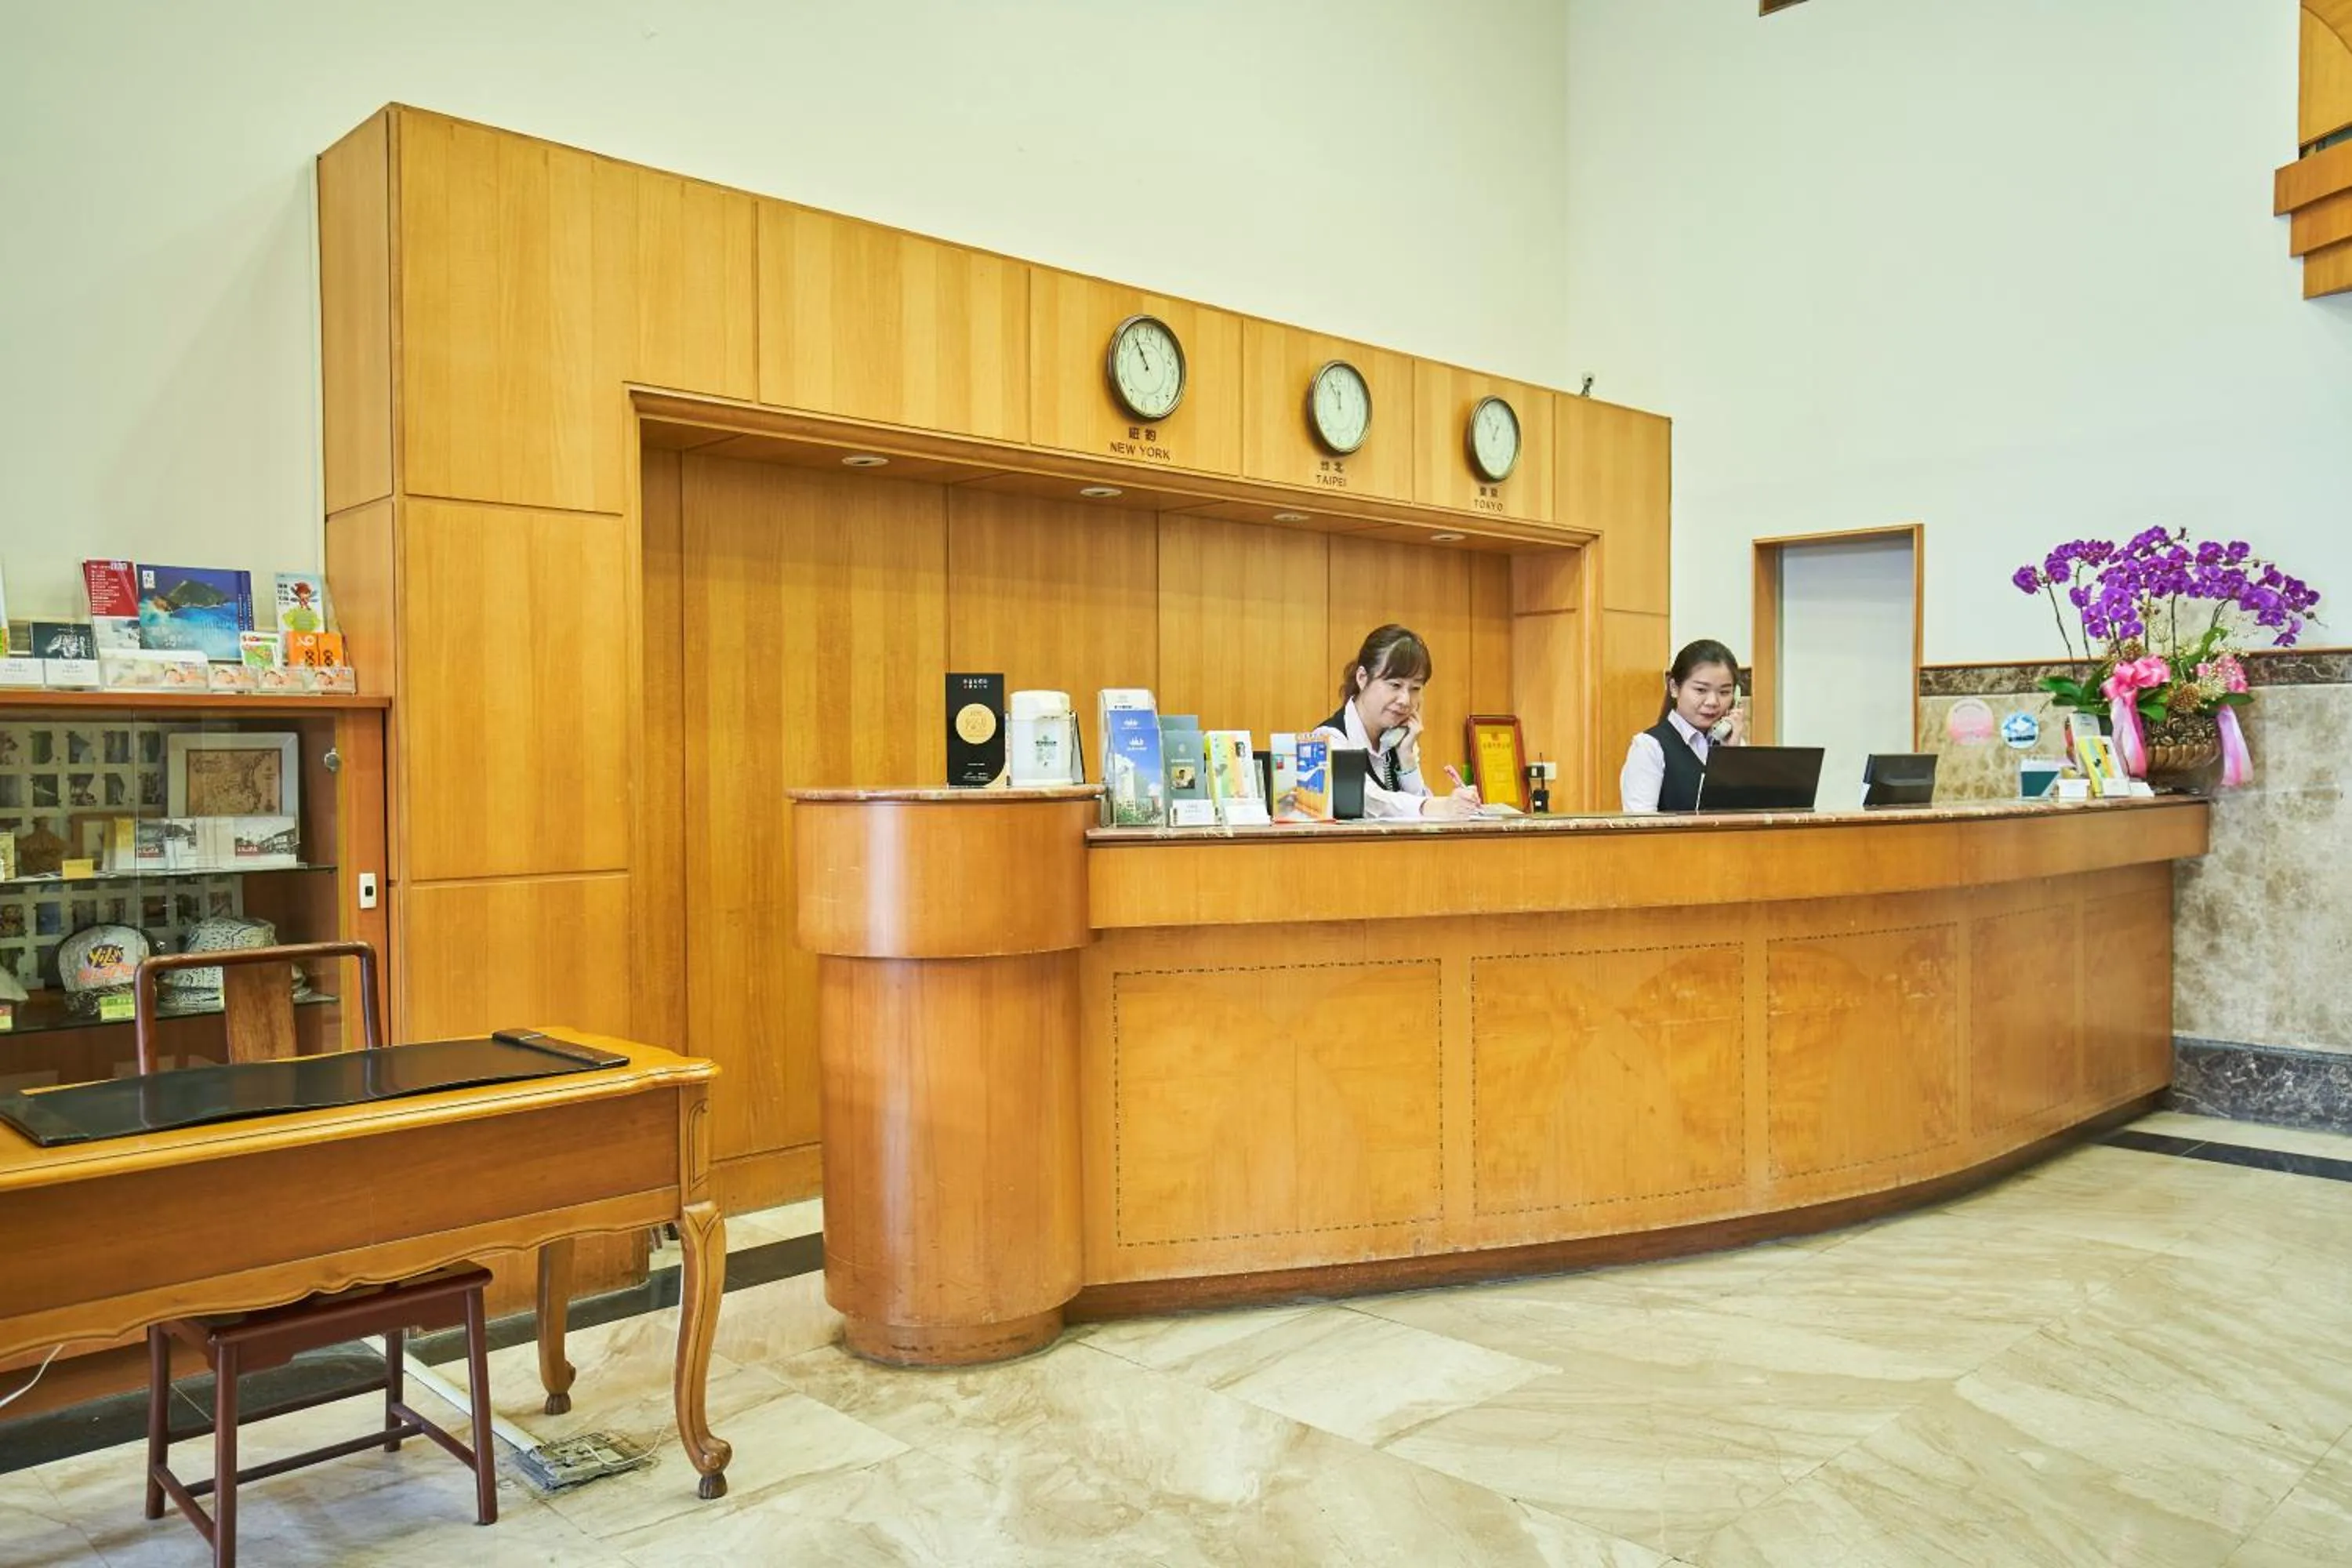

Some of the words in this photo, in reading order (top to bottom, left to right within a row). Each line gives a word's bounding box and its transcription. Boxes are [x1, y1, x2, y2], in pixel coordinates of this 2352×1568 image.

[1109, 441, 1136, 456] NEW
[1139, 444, 1171, 461] YORK
[1316, 474, 1347, 487] TAIPEI
[1474, 499, 1504, 512] TOKYO
